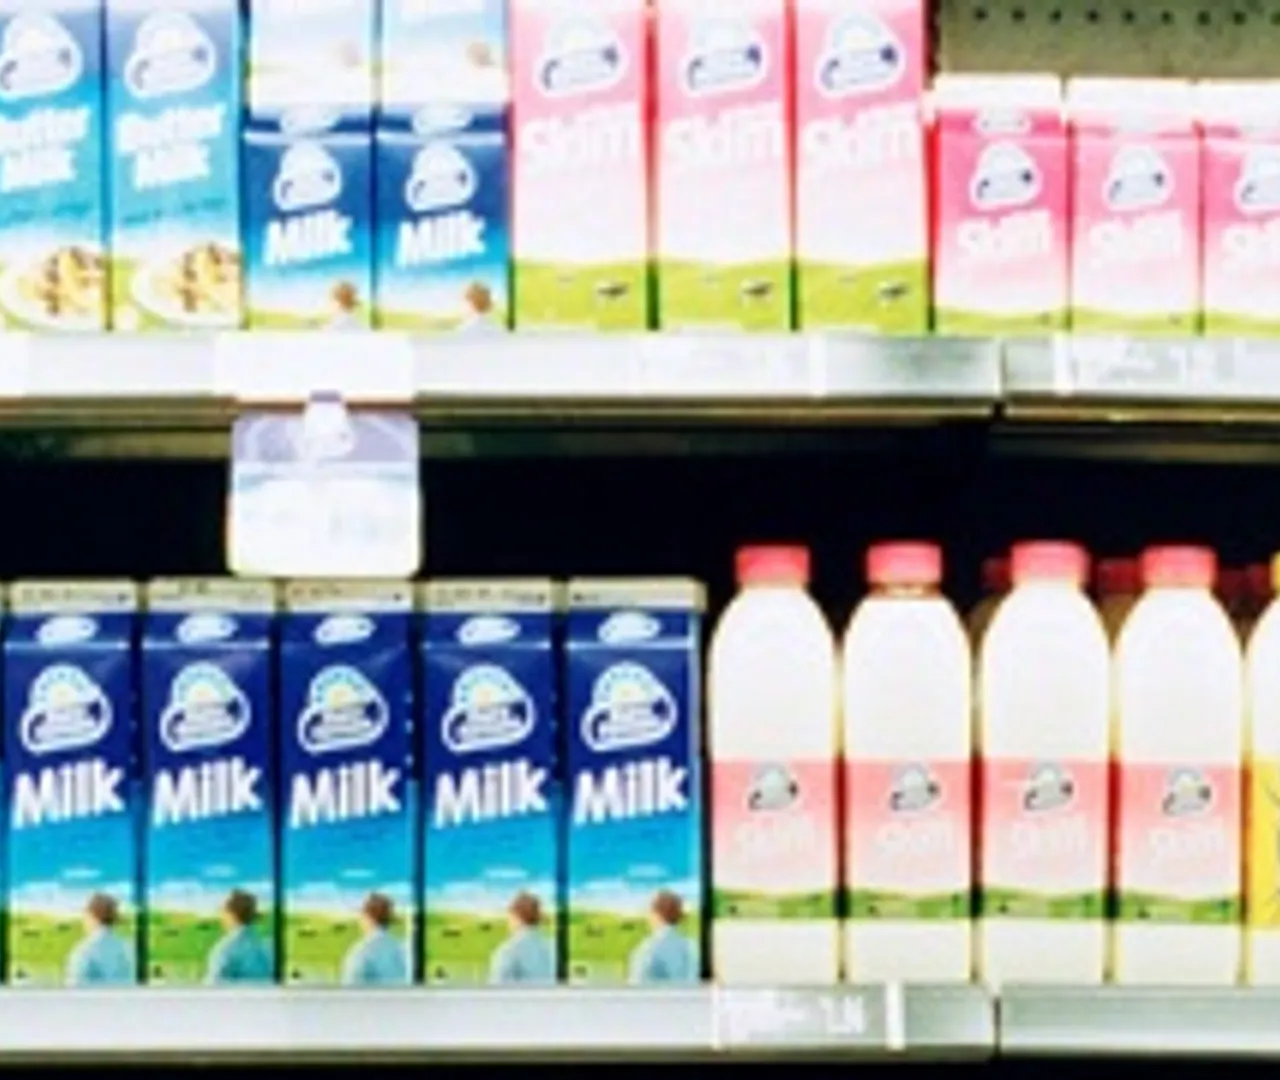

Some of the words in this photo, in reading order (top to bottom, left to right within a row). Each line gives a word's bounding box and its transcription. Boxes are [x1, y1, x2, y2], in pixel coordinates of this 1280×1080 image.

[116, 105, 223, 155] Butter
[522, 104, 637, 162] Skim
[666, 102, 783, 160] Skim
[806, 104, 919, 160] Skim
[0, 146, 75, 192] Milk
[133, 144, 209, 190] Milk
[263, 209, 350, 269] Milk
[396, 210, 484, 271] Milk
[12, 758, 123, 828] Milk
[153, 756, 261, 825] Milk
[289, 760, 400, 828] Milk
[434, 758, 547, 827] Milk
[573, 757, 687, 824] Milk
